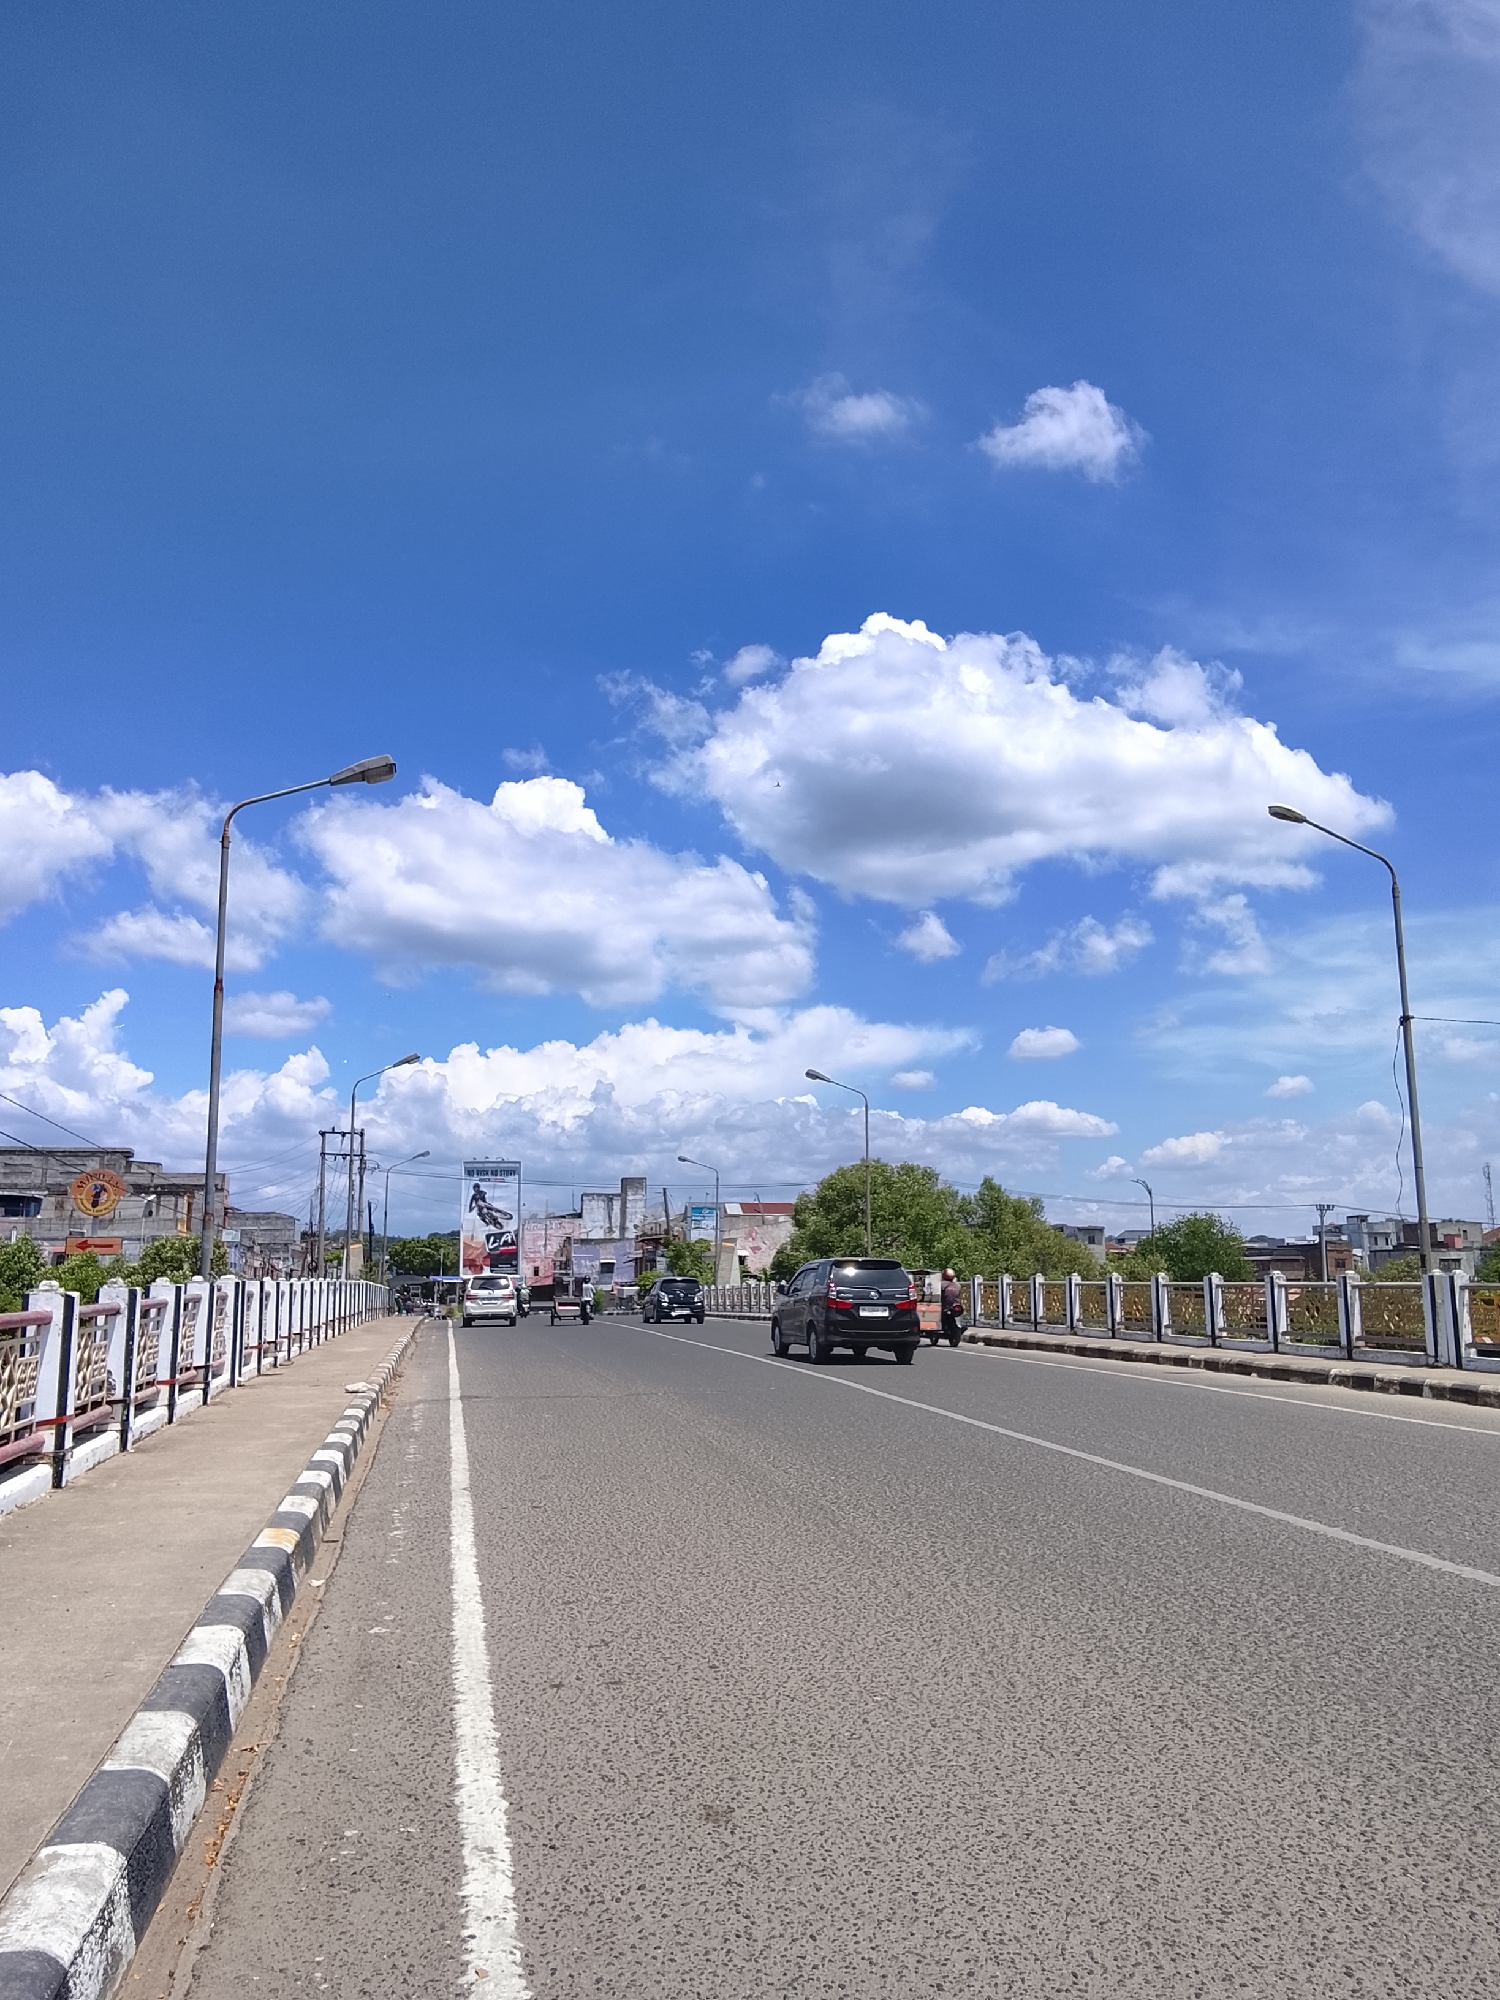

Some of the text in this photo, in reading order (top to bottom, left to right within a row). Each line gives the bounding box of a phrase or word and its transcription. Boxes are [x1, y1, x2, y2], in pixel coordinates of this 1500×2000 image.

[467, 1169, 517, 1177] NO RISK NO STORY
